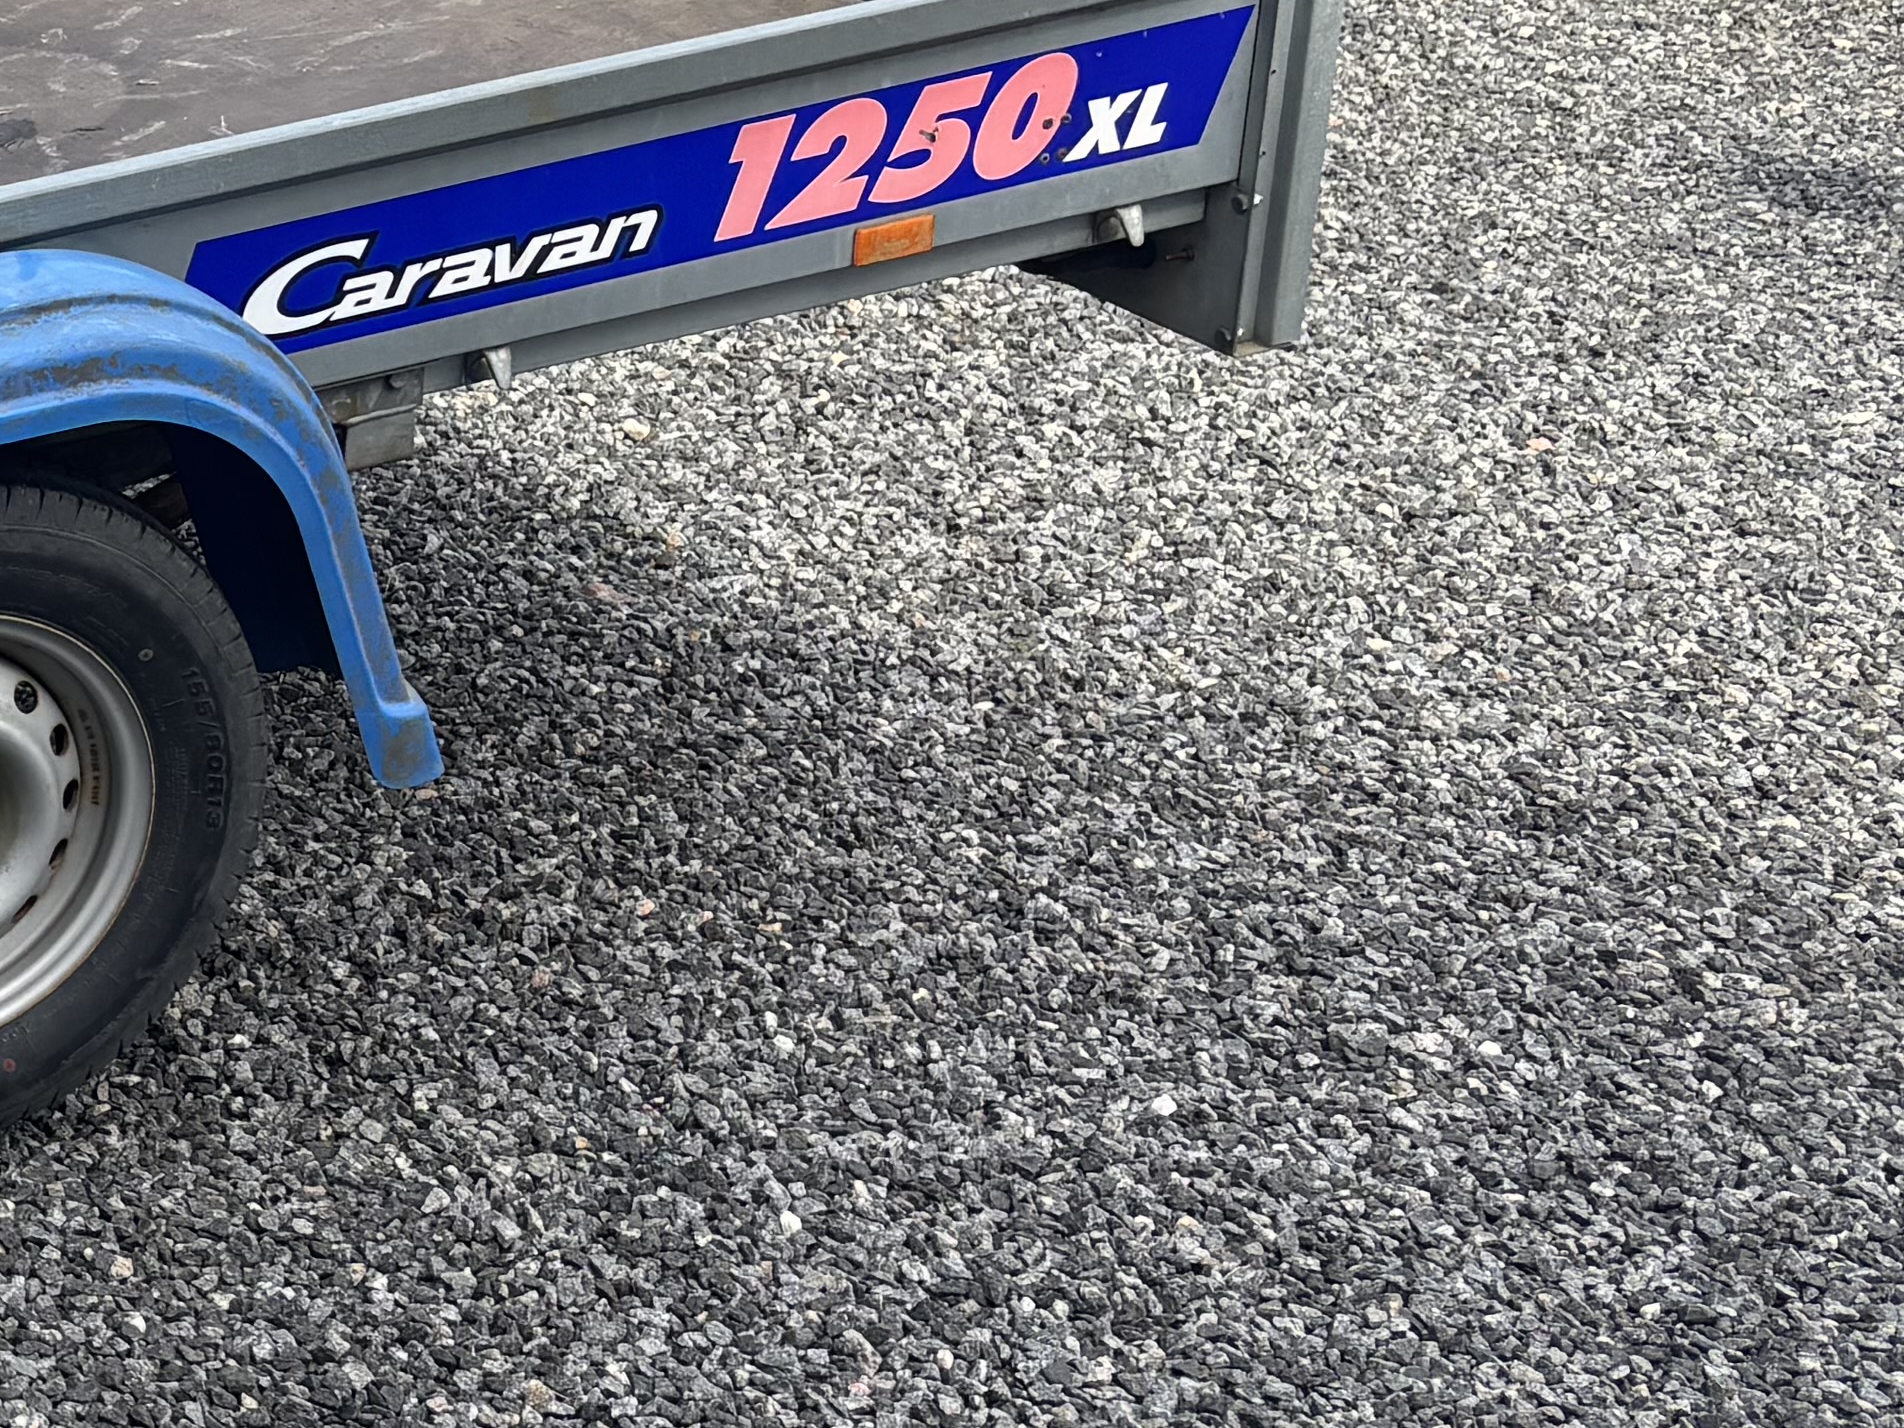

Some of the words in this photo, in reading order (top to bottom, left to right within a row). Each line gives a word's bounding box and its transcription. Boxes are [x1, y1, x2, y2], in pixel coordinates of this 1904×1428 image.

[242, 207, 658, 334] Caravan
[714, 51, 1079, 241] 1250
[1064, 81, 1169, 163] XL
[180, 666, 225, 830] 155/80R13
